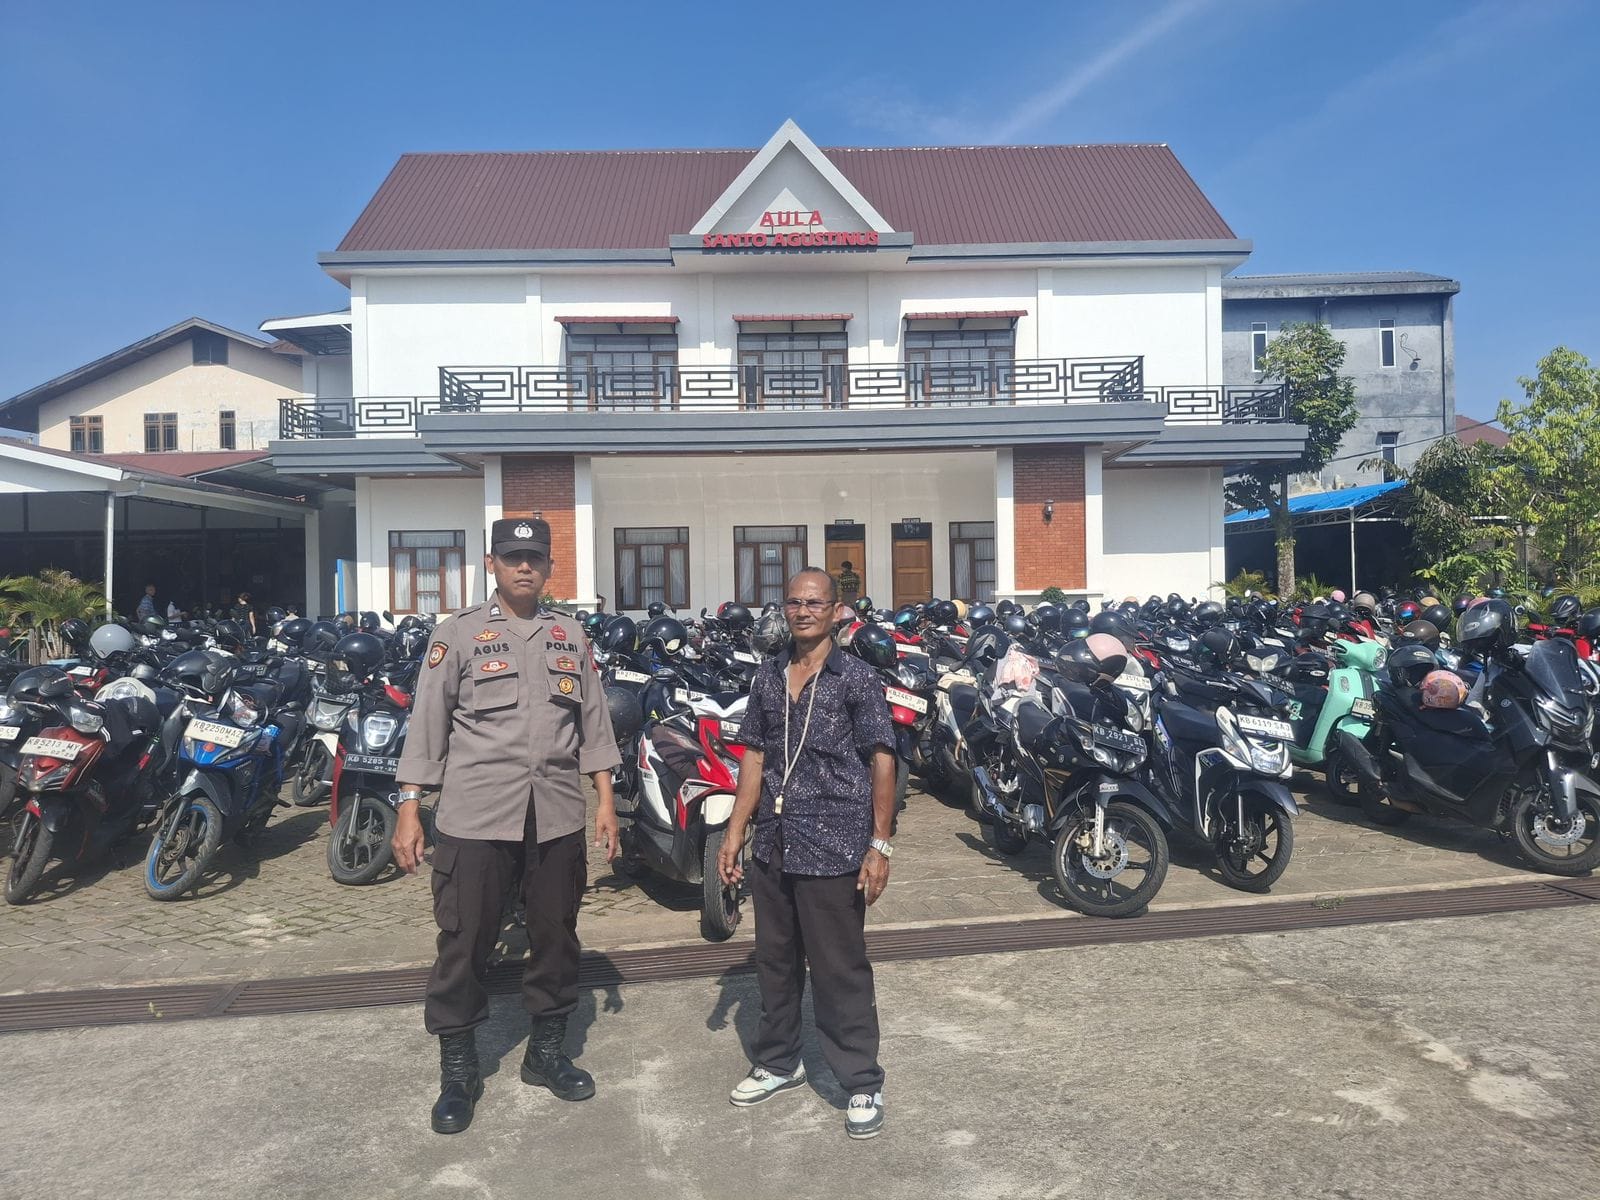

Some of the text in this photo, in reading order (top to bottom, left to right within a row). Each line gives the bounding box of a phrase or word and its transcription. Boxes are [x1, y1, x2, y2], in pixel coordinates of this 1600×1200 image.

[759, 210, 824, 227] AULA
[702, 232, 879, 248] SANTO AGUSTINUS
[473, 643, 510, 656] AGUS
[546, 641, 578, 653] POLRI
[1240, 716, 1251, 725] KB
[1094, 726, 1105, 736] KB
[1108, 730, 1128, 743] 2921
[347, 755, 360, 763] KB
